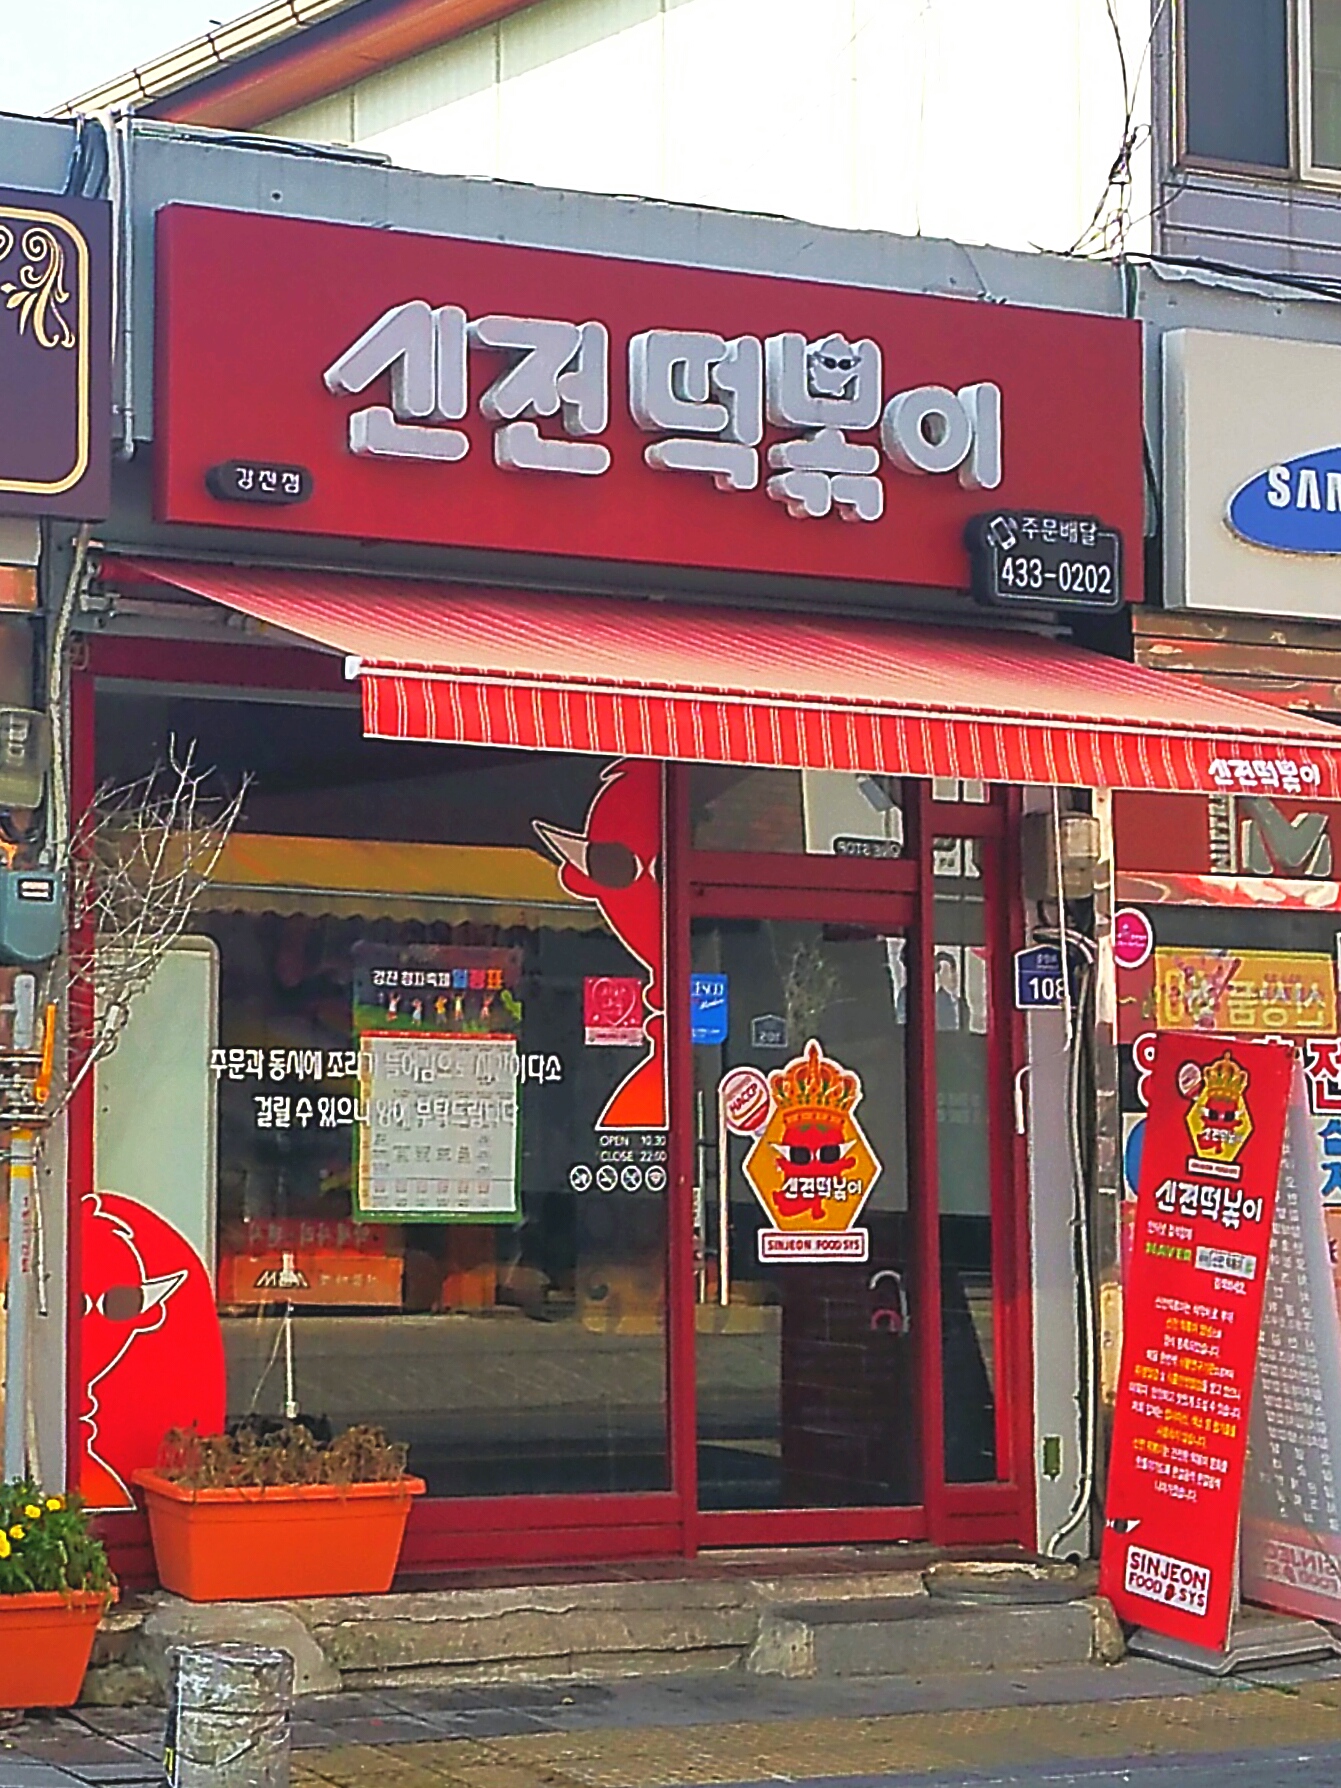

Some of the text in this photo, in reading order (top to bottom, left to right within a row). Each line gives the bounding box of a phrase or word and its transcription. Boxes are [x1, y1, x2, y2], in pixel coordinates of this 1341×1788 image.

[234, 467, 300, 494] 강진점
[1021, 516, 1098, 546] 주문배달
[1001, 556, 1112, 595] 433-0202
[1208, 758, 1321, 794] 신전떡볶이
[209, 1048, 265, 1080] 주문과
[268, 1049, 323, 1081] 동시에
[253, 1096, 291, 1128] 걸릴
[295, 1096, 314, 1128] 수
[317, 1096, 371, 1128] 있으니
[729, 1082, 758, 1113] HACCP
[599, 1135, 630, 1147] OPEN
[600, 1150, 634, 1162] CLOSE
[1155, 1179, 1264, 1231] 신전떡볶이
[1129, 1551, 1207, 1591] SINJEON
[1128, 1572, 1206, 1608] FOOD SYS
